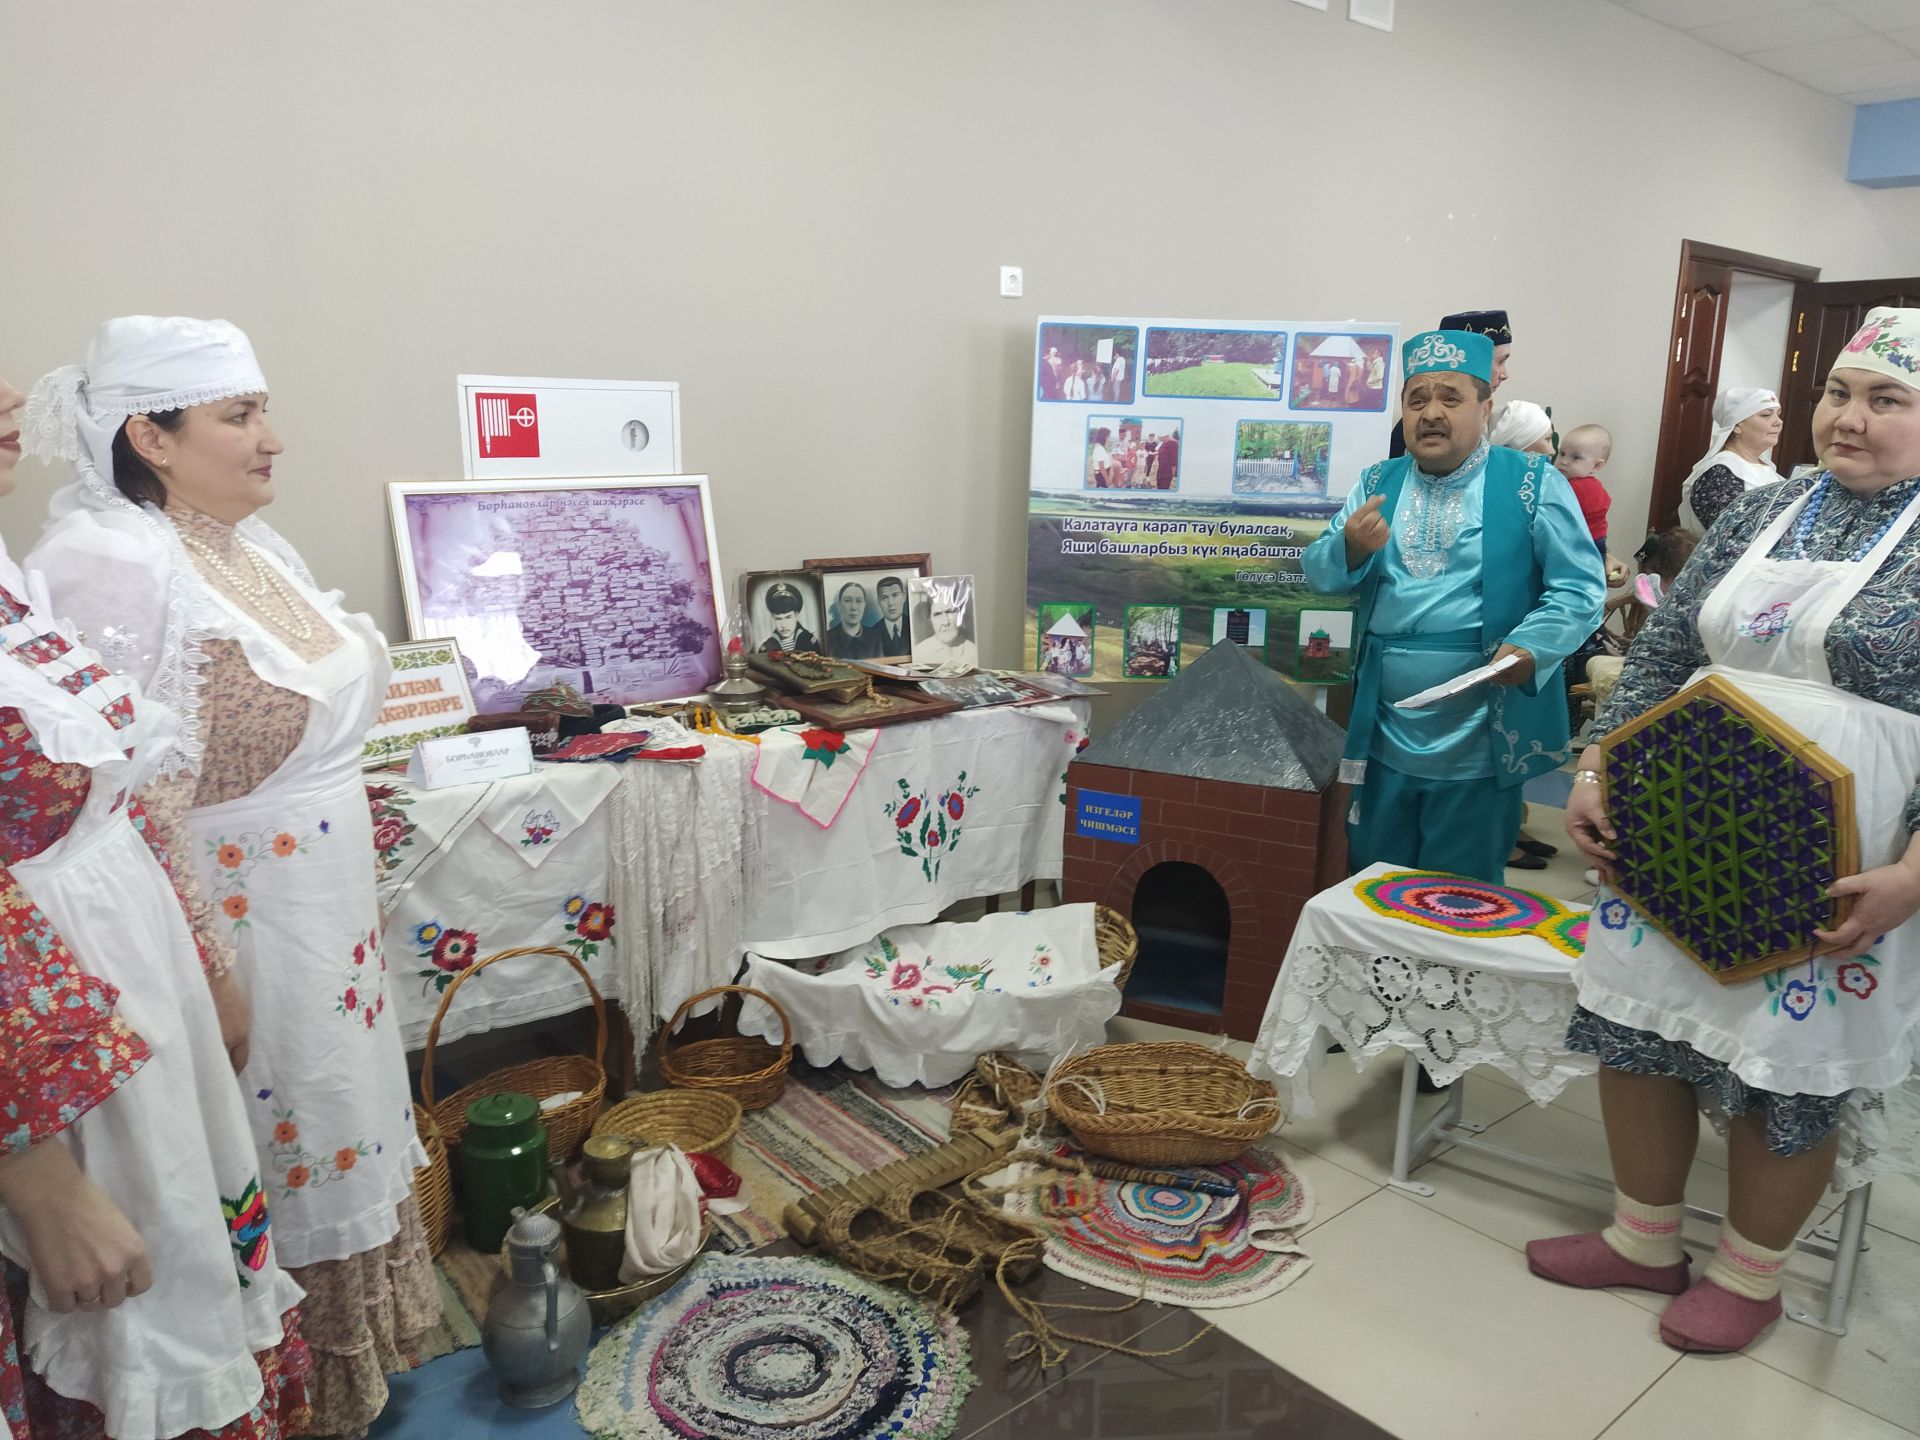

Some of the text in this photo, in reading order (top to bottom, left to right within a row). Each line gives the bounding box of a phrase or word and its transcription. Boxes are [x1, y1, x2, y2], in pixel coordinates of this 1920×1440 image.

[478, 499, 556, 513] Борһановлар
[1063, 517, 1293, 539] Калатауга карап тау булалсак,
[1062, 540, 1096, 554] Яши
[1100, 540, 1188, 557] башларбыз
[1192, 545, 1218, 558] күк
[385, 678, 443, 699] ИЛӘМ
[1085, 804, 1133, 819] ИЗГЕЛӘР
[1080, 819, 1137, 835] ЧИШМӘСЕ
